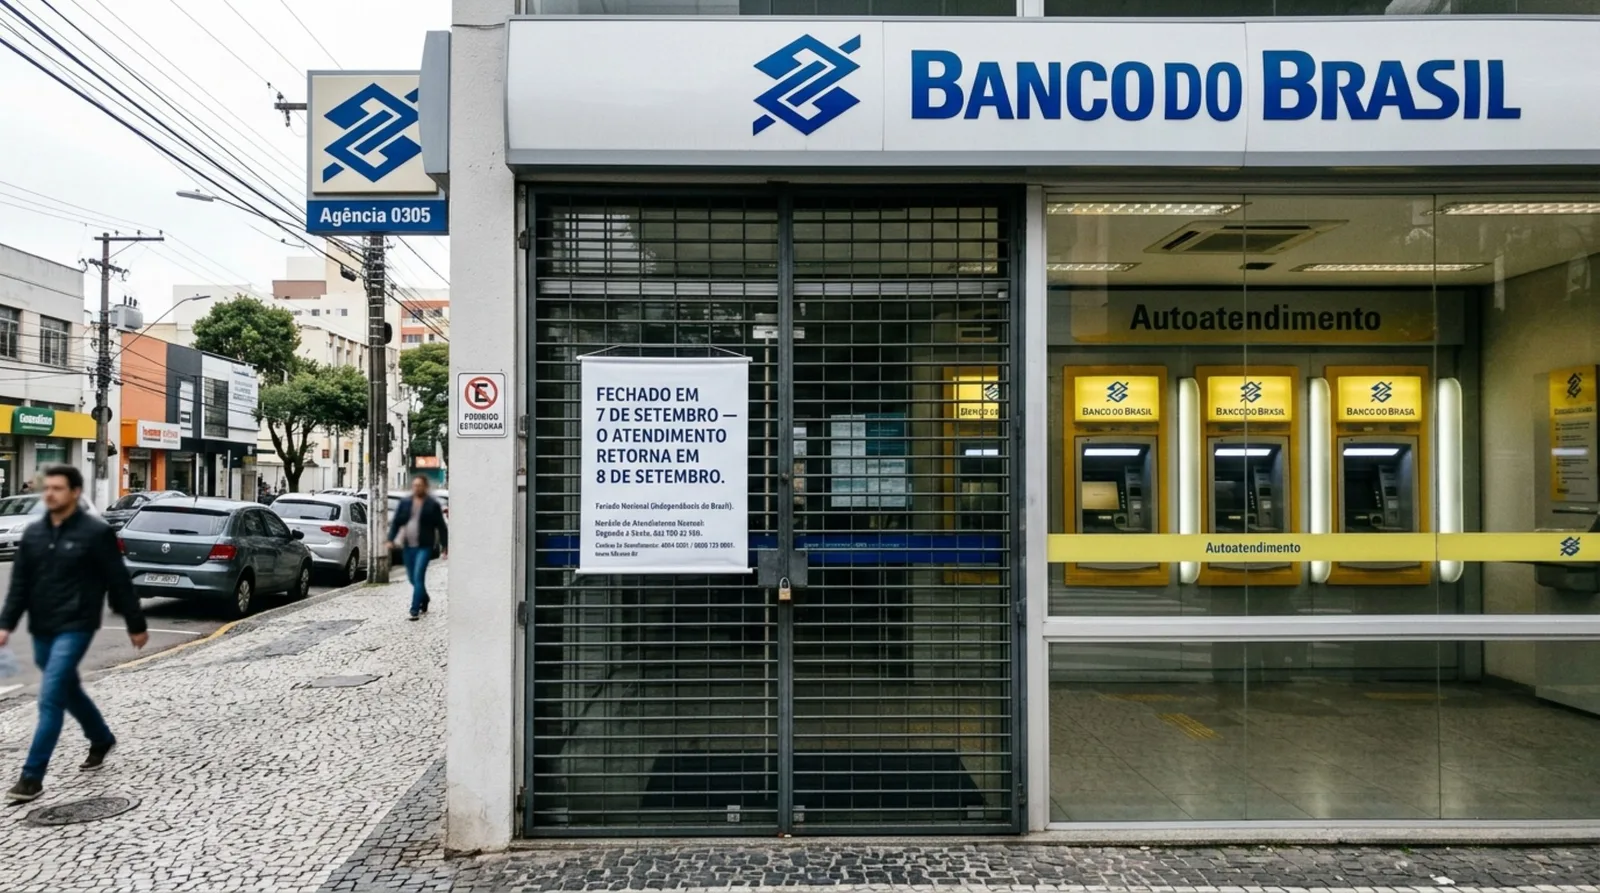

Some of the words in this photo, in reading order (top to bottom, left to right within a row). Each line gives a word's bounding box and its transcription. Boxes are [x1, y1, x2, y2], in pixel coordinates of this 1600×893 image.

[912, 50, 1155, 121] BANCO
[1165, 62, 1243, 121] DO
[1263, 50, 1521, 121] BRASIL
[320, 207, 387, 227] Agência
[391, 207, 431, 223] 0305
[1130, 304, 1382, 331] Autoatendimento
[596, 387, 671, 401] FECHADO
[676, 387, 699, 402] EM
[596, 407, 606, 422] 7
[609, 408, 630, 422] DE
[635, 407, 719, 422] SETEMBRO
[1082, 407, 1112, 416] BANCO
[596, 428, 608, 443] O
[612, 428, 727, 443] ATENDIMENTO
[596, 449, 672, 463] RETORNA
[676, 449, 700, 463] EM
[596, 469, 606, 484] 8
[610, 469, 631, 484] DE
[635, 469, 725, 484] SETEMBRO.
[1205, 541, 1302, 554] Autoatendimento
